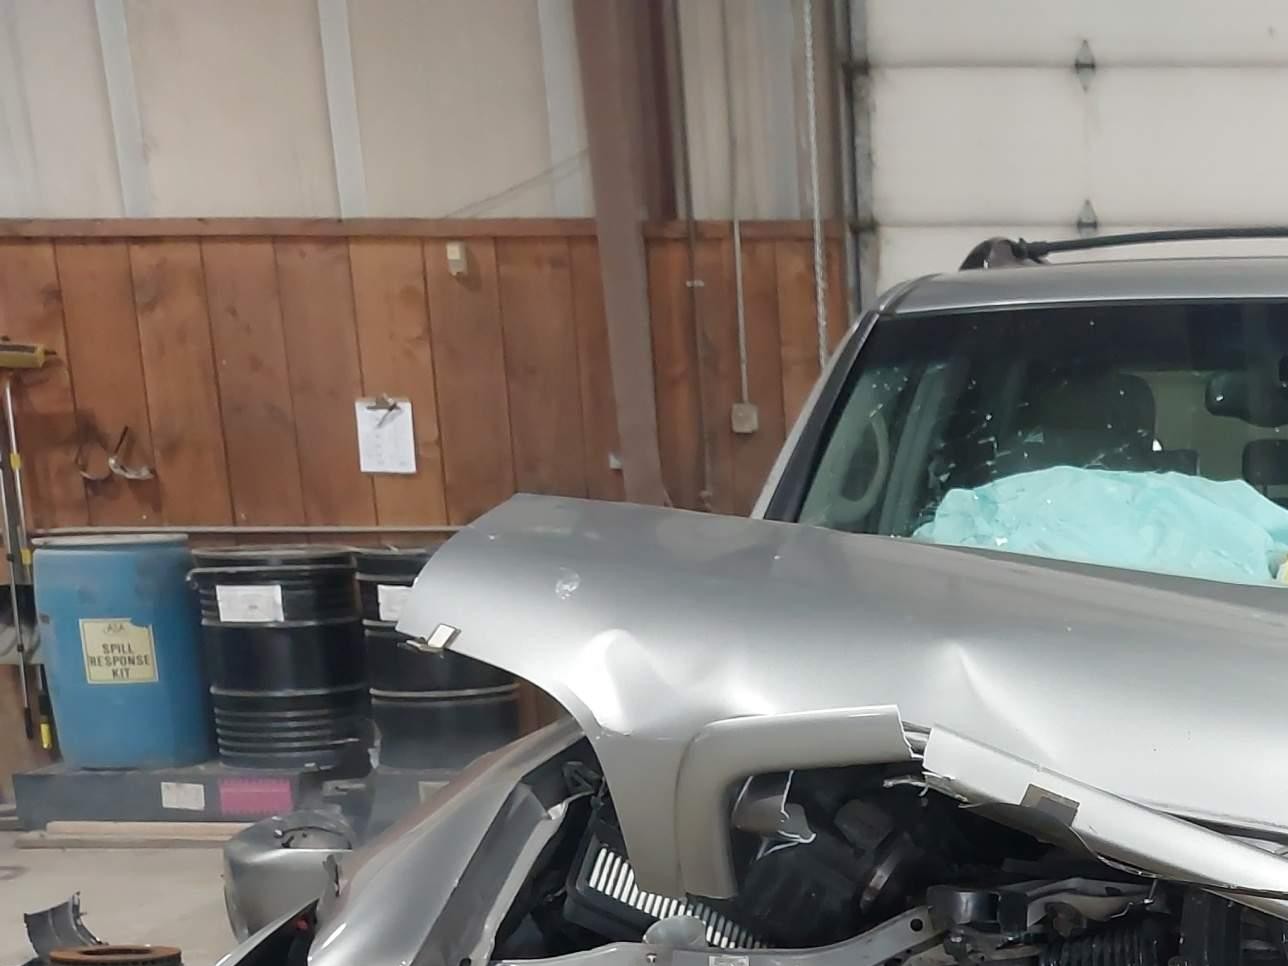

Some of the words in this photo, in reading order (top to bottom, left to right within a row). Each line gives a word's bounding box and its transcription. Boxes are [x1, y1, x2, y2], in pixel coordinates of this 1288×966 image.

[102, 643, 133, 655] SPILL
[88, 654, 151, 667] RESPONSE
[112, 668, 130, 680] KIT
